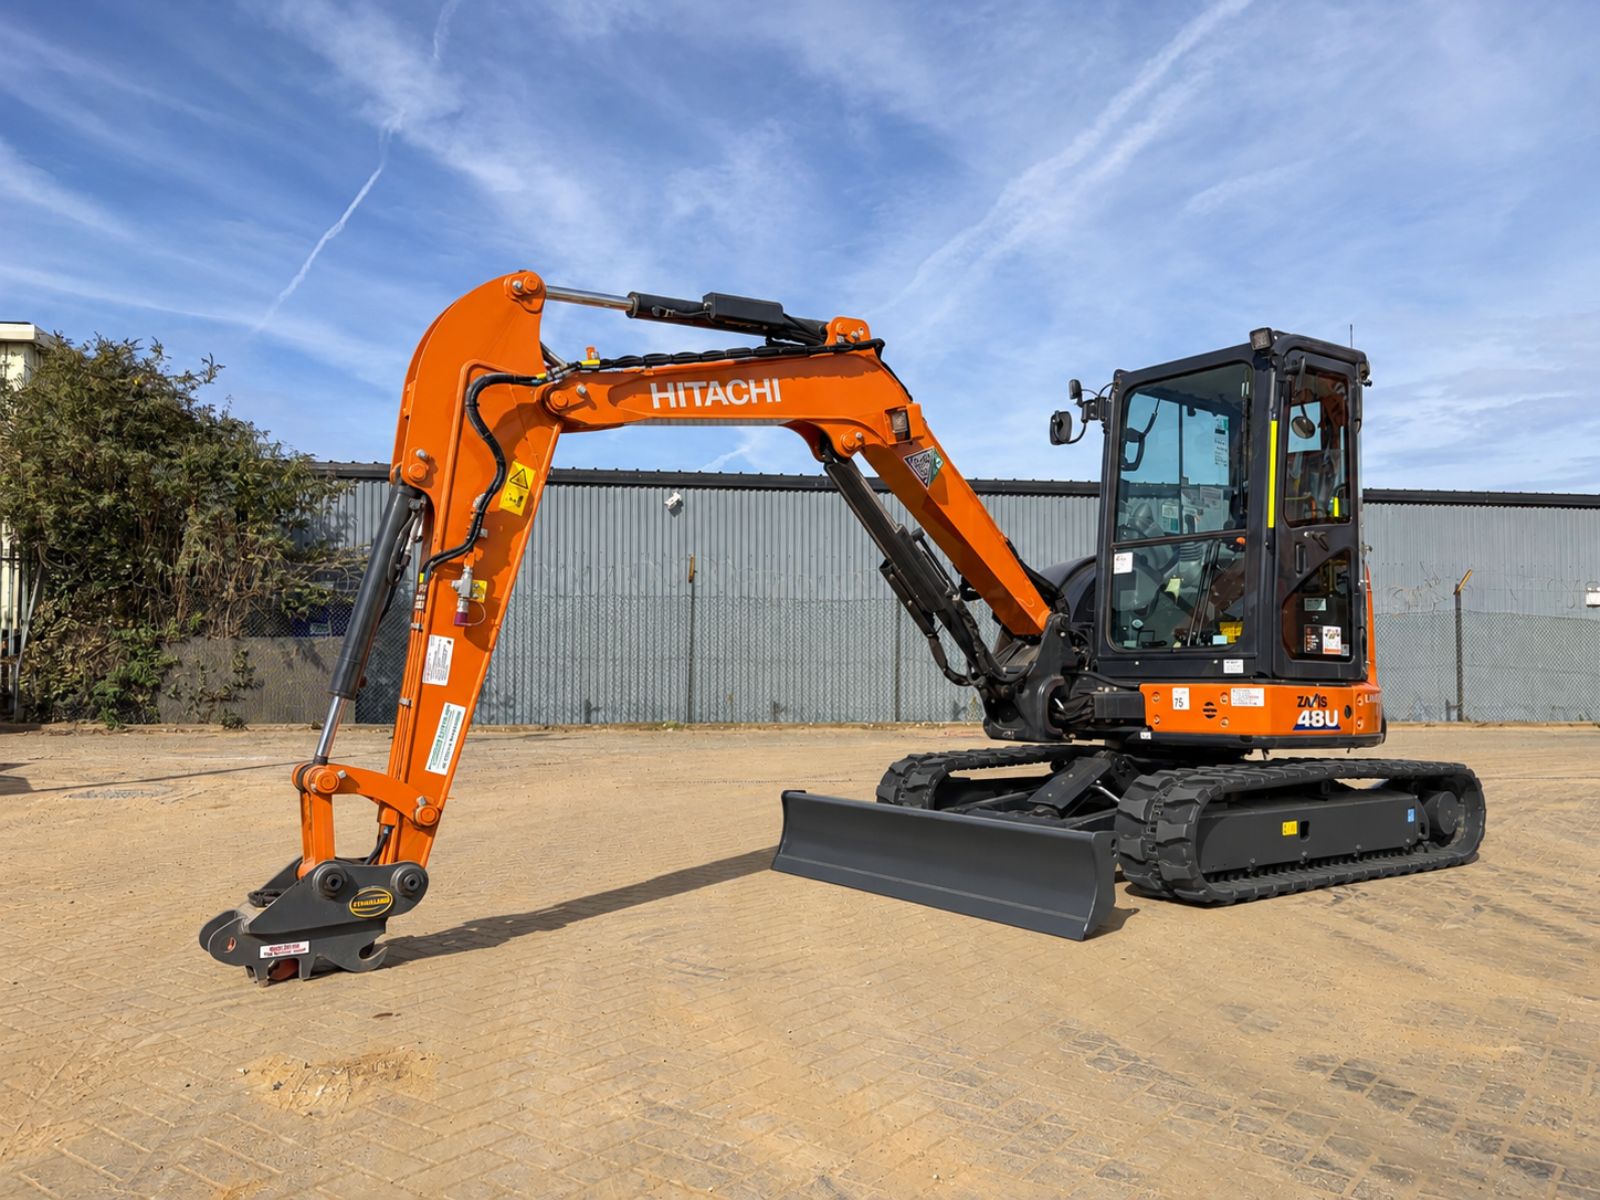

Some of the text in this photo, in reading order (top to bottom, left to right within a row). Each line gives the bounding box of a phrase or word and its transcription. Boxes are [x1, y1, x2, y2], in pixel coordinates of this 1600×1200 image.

[650, 378, 781, 409] HITACHI
[1174, 697, 1184, 708] 75
[1297, 709, 1339, 727] 48U
